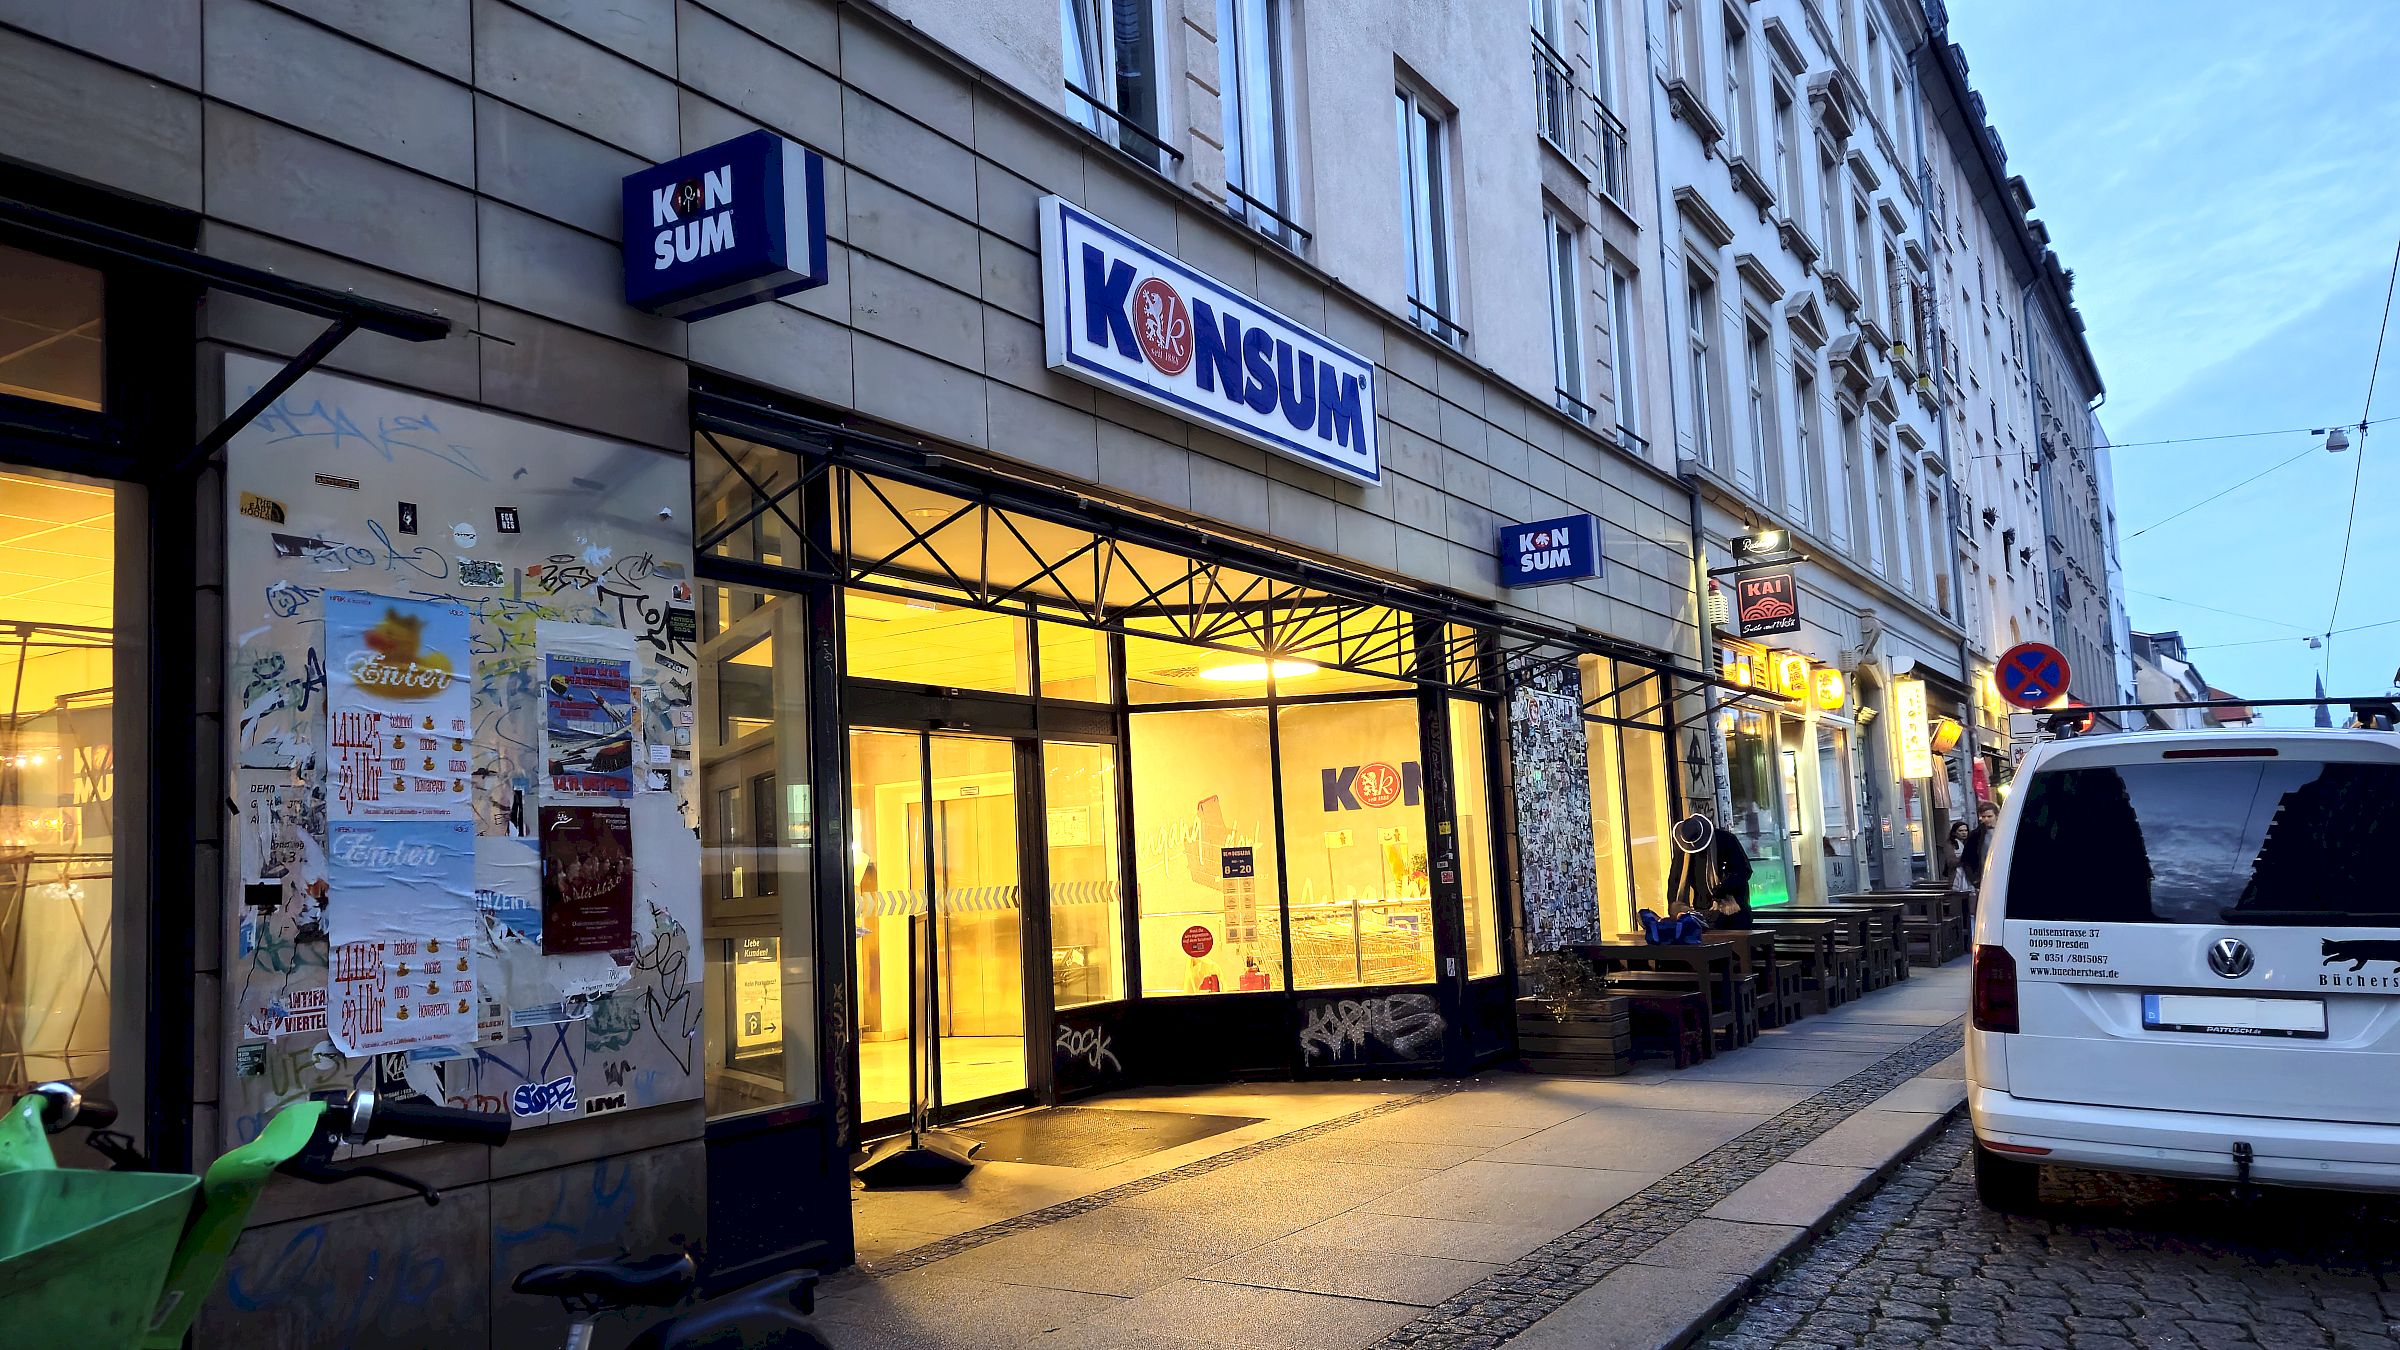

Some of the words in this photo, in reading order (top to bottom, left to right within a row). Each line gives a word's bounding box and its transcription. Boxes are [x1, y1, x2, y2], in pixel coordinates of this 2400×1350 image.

[654, 210, 736, 270] SUM
[1082, 241, 1368, 456] KONSUM
[1520, 548, 1571, 573] SUM
[1747, 580, 1782, 596] KAI
[355, 752, 382, 800] Uhr
[1224, 866, 1231, 874] 8
[1240, 865, 1252, 874] 20
[2029, 928, 2087, 937] Louisenstrasse
[2089, 930, 2100, 938] 37
[744, 939, 760, 948] Liebe
[2029, 939, 2053, 948] 01099
[2056, 940, 2089, 949] Dresden
[744, 948, 769, 958] Kunden!
[2044, 954, 2064, 962] 0351
[2030, 967, 2120, 978] www.buechersbest.de
[2319, 974, 2399, 988] Büchers
[288, 990, 326, 1009] ANTIFA
[358, 984, 386, 1034] Uhr
[284, 1013, 327, 1032] VIERTEL
